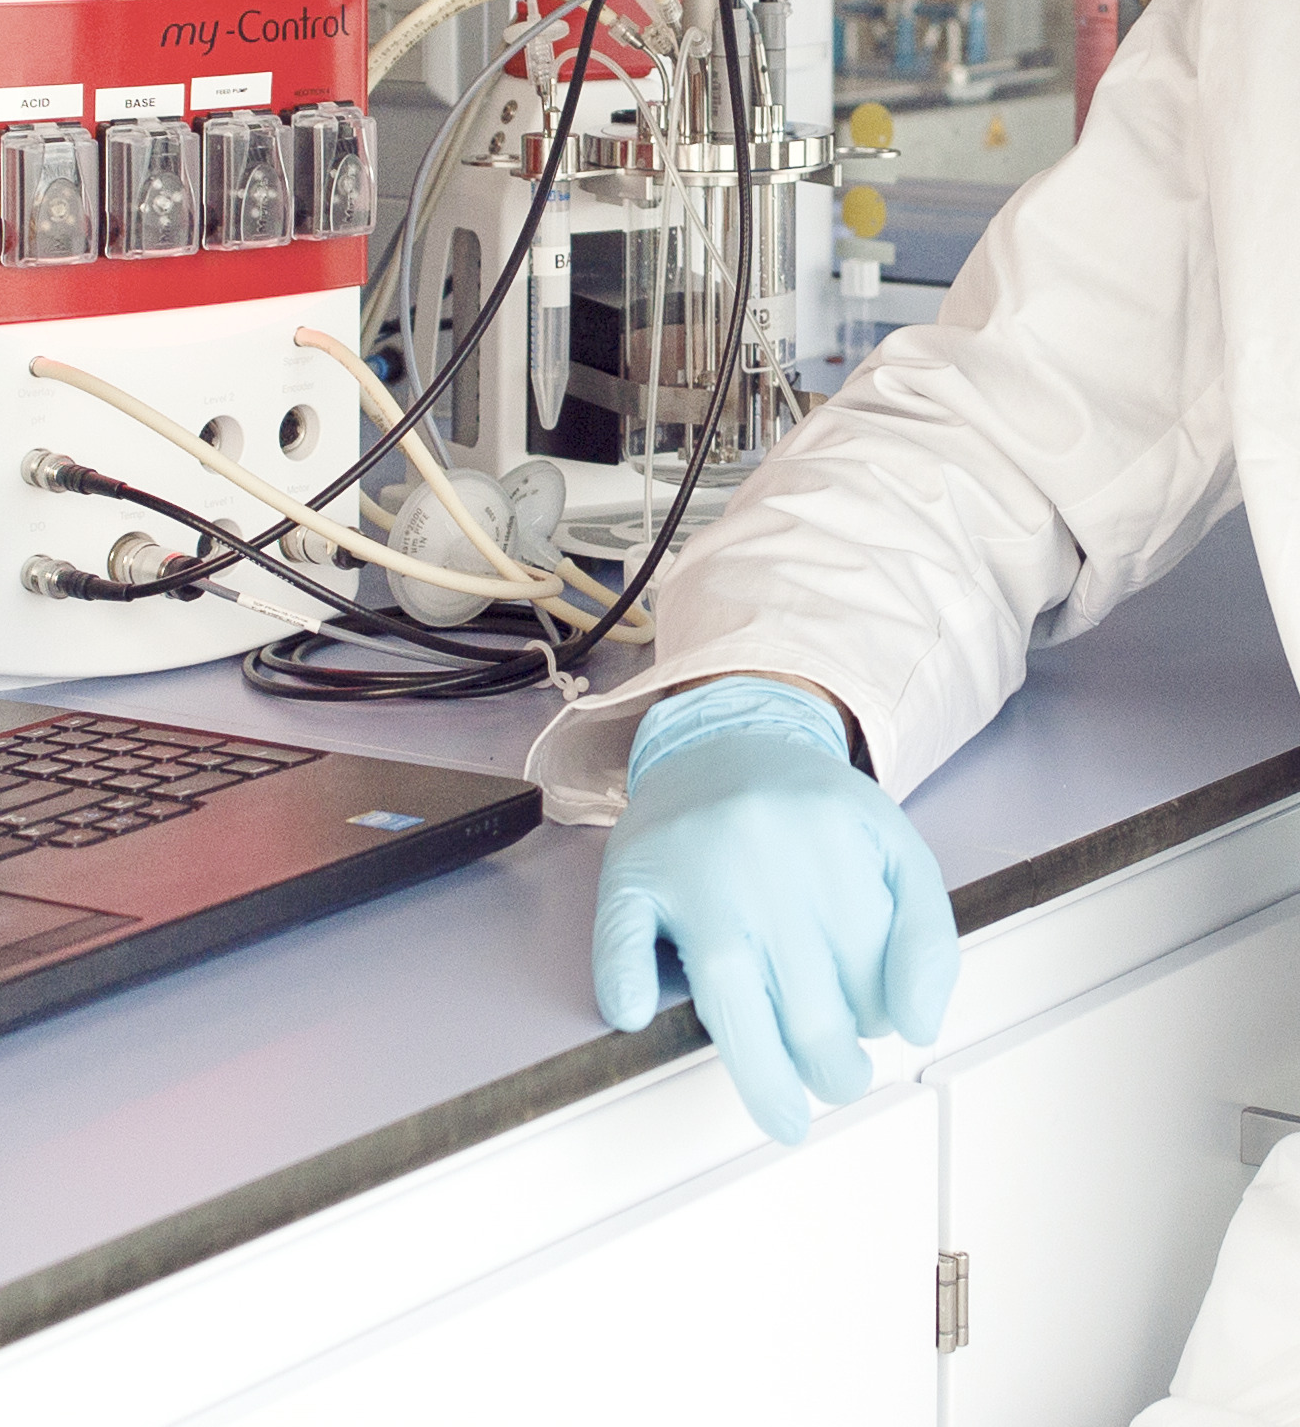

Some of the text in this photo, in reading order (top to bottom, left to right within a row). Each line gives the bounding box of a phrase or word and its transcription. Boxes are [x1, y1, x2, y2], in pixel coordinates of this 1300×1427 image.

[160, 4, 350, 56] my-Control
[21, 97, 50, 109] ACID
[125, 97, 156, 109] BASE
